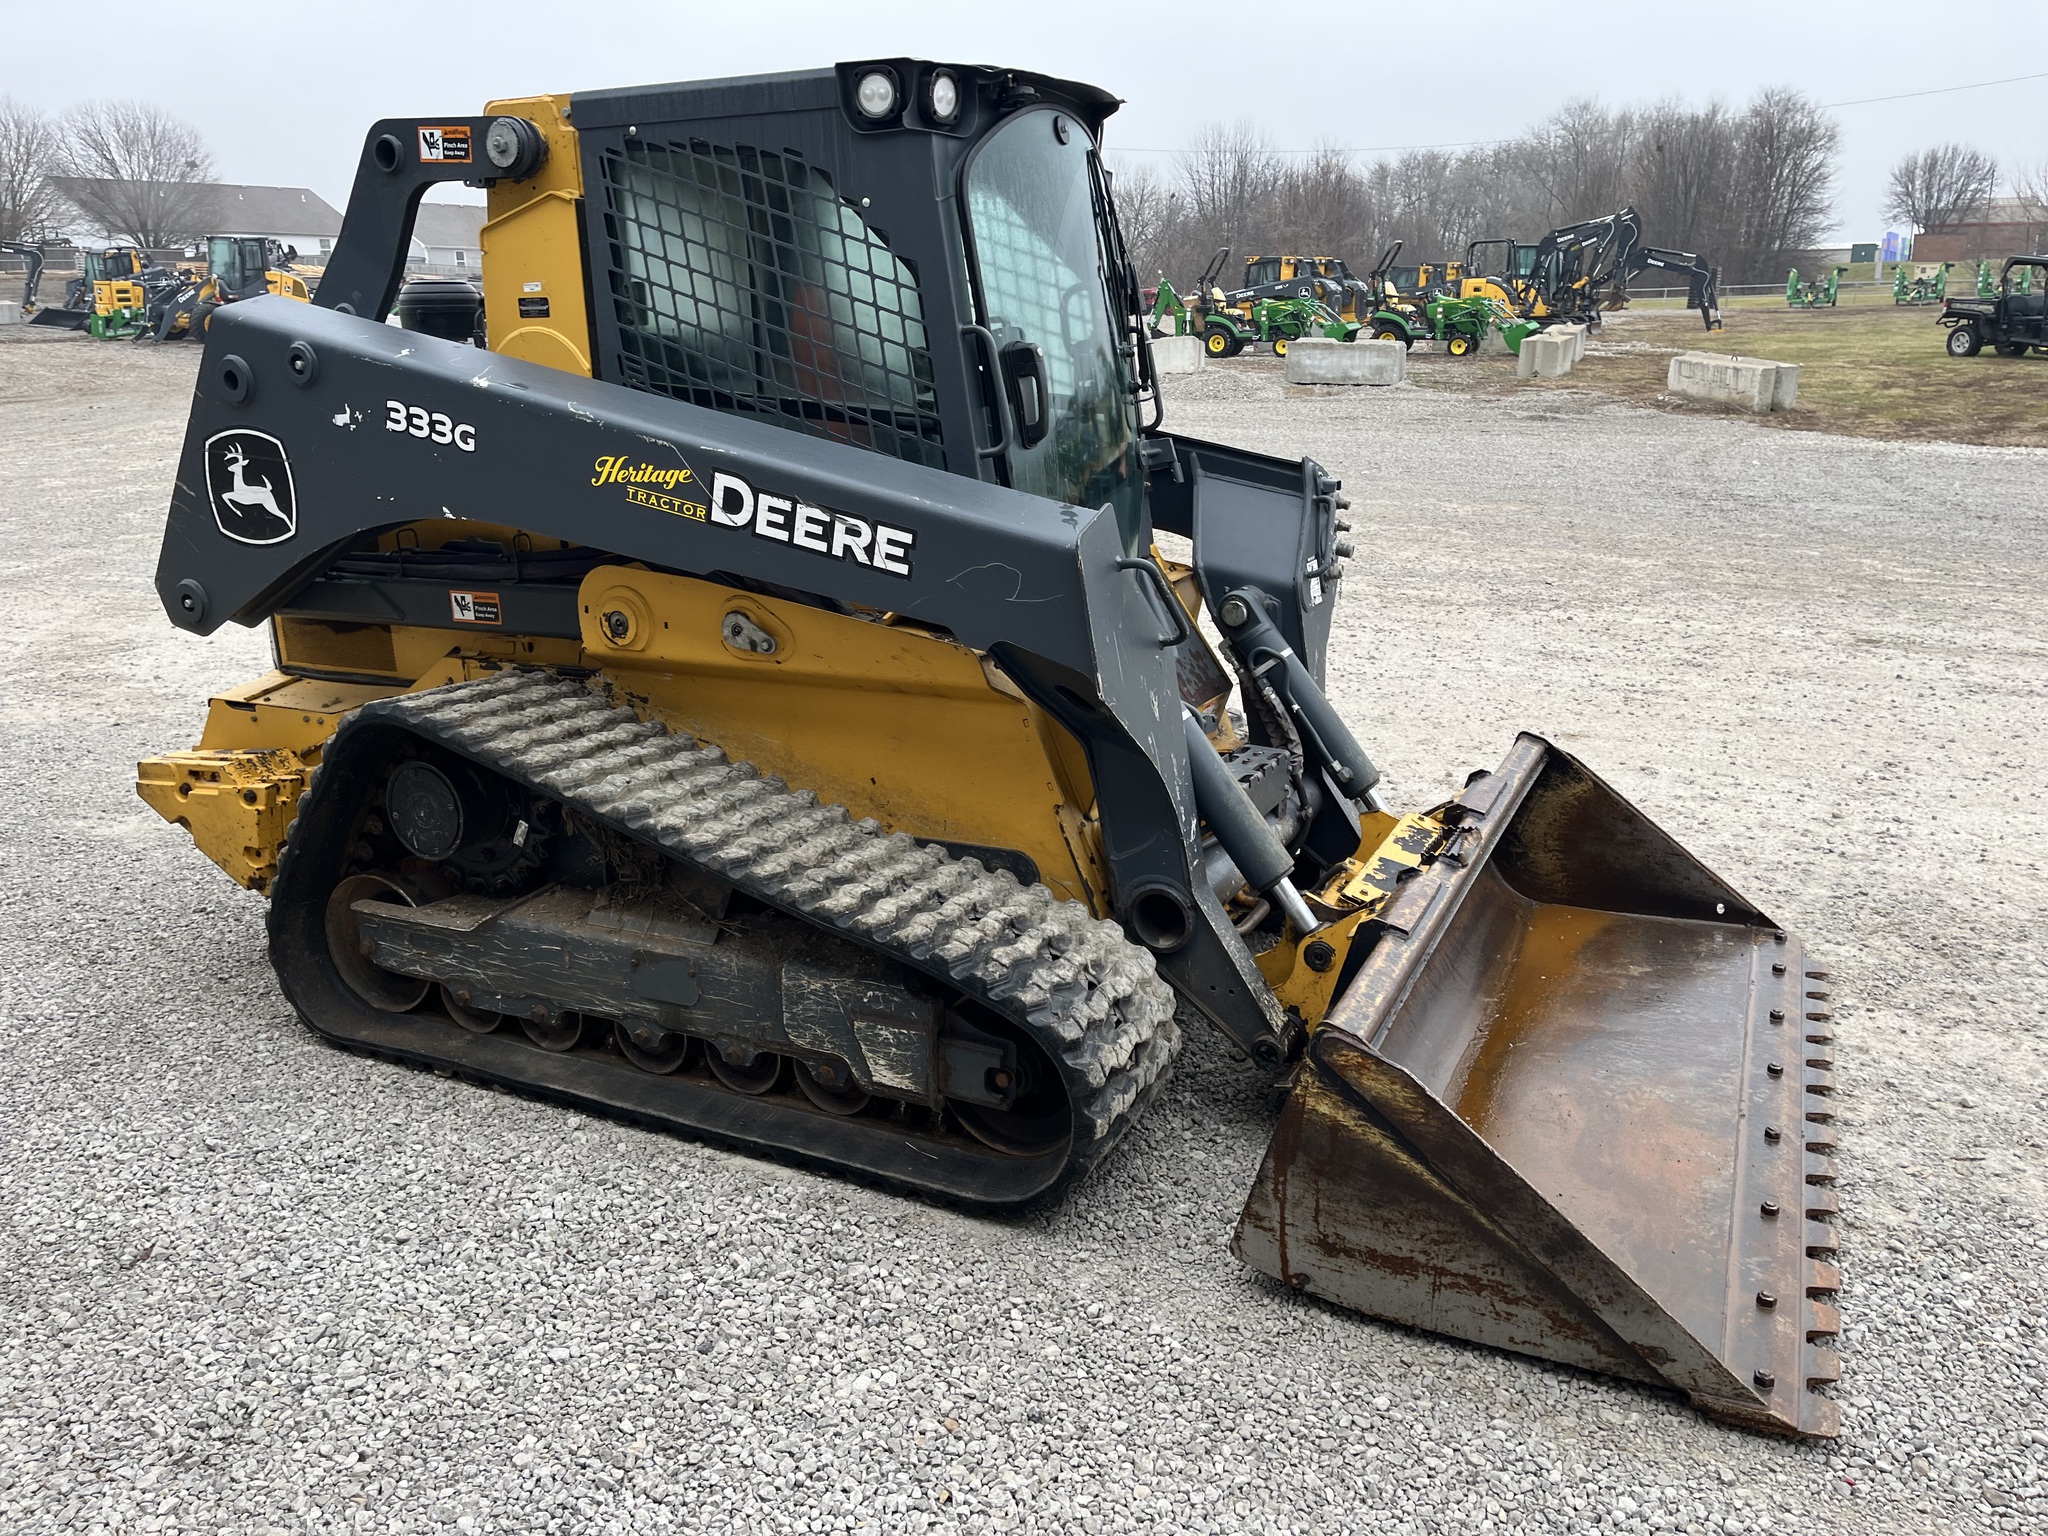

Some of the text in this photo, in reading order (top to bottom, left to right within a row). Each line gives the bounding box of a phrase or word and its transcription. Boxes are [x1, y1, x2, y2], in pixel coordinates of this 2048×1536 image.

[385, 400, 476, 452] 333G
[591, 455, 693, 490] Heritage
[627, 487, 706, 520] TRACTOR
[711, 471, 914, 576] DEERE
